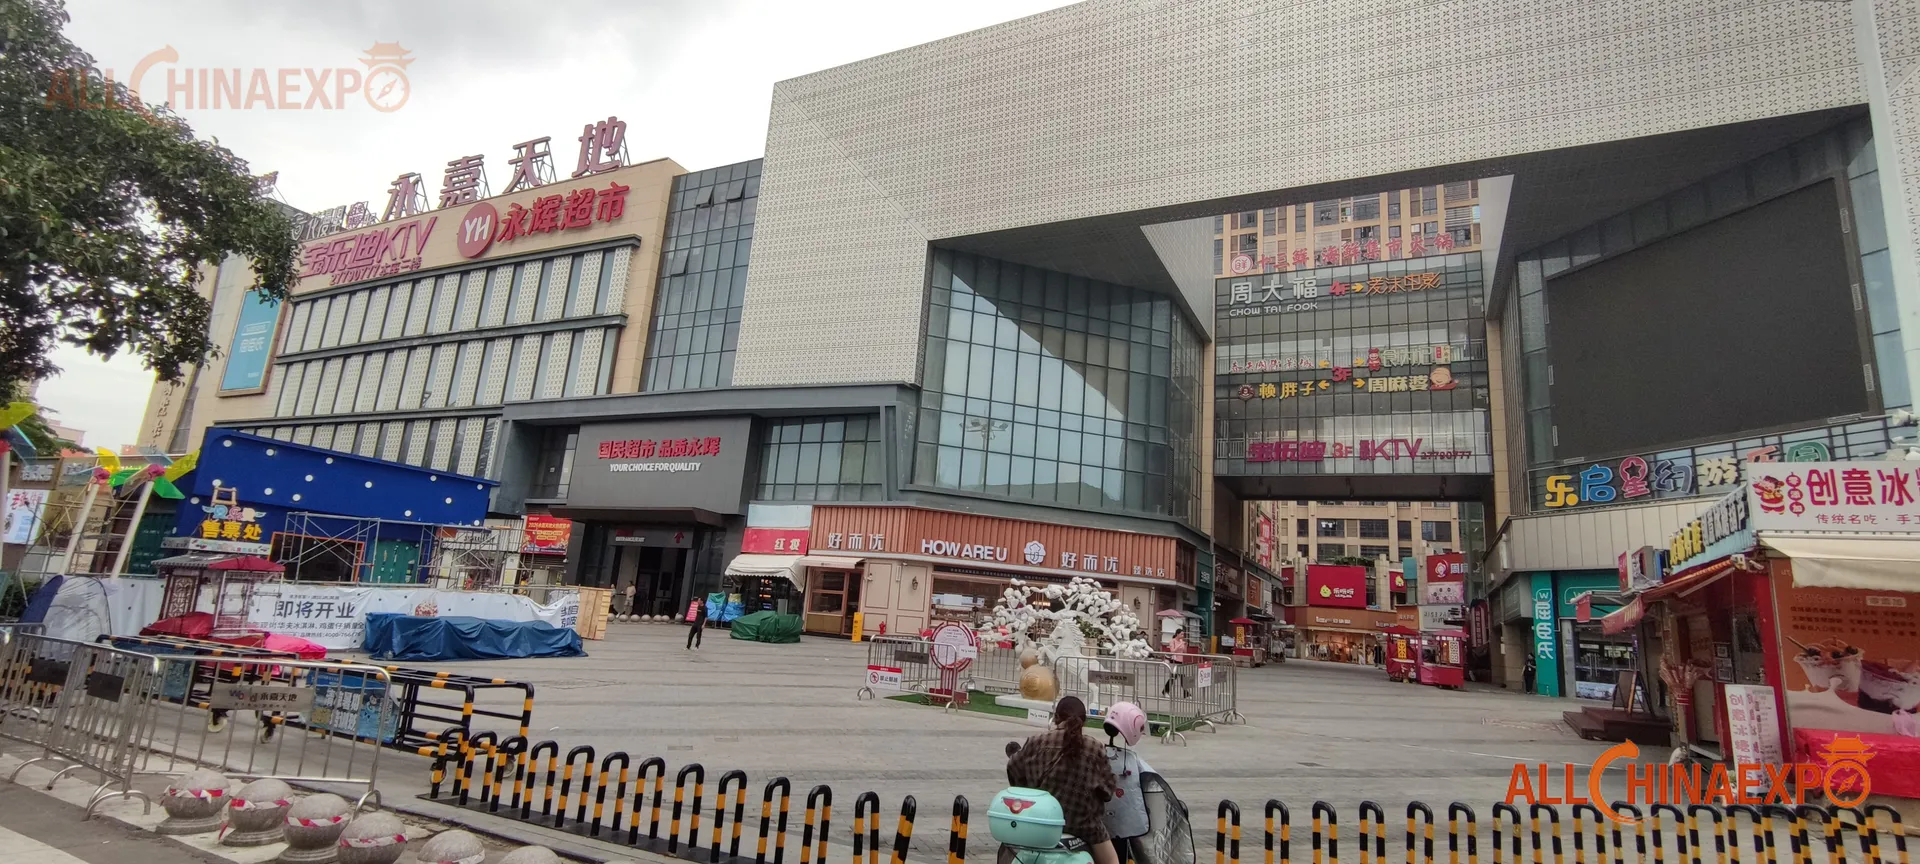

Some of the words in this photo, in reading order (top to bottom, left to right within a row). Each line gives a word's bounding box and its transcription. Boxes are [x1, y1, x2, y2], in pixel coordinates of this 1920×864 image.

[383, 117, 627, 221] 永嘉天地
[497, 181, 631, 243] 永辉超市
[464, 213, 491, 241] YH
[1322, 233, 1455, 264] 海鲜集市火锅
[1230, 277, 1318, 306] 周大福
[1329, 281, 1350, 297] 4F
[1229, 307, 1261, 318] CHOW
[1264, 305, 1282, 315] TAI
[1287, 302, 1318, 313] FOOK
[1331, 366, 1352, 382] 3F
[1259, 380, 1316, 400] 赖胖子
[1368, 375, 1428, 394] 周麻婆
[598, 439, 656, 460] 国民超市
[658, 437, 721, 458] 品质永辉
[1332, 442, 1353, 458] 3F
[610, 463, 628, 472] YOUR
[628, 463, 655, 472] CHOICE
[655, 463, 670, 471] FOR
[670, 462, 701, 473] QUALITY
[202, 519, 262, 540] 售票处
[827, 532, 885, 551] 好而优
[922, 538, 961, 557] HOW
[961, 542, 994, 561] ARE
[996, 547, 1008, 562] U
[1061, 551, 1119, 574] 好而优
[273, 600, 355, 619] 即将开业
[260, 691, 298, 702] 永嘉天地
